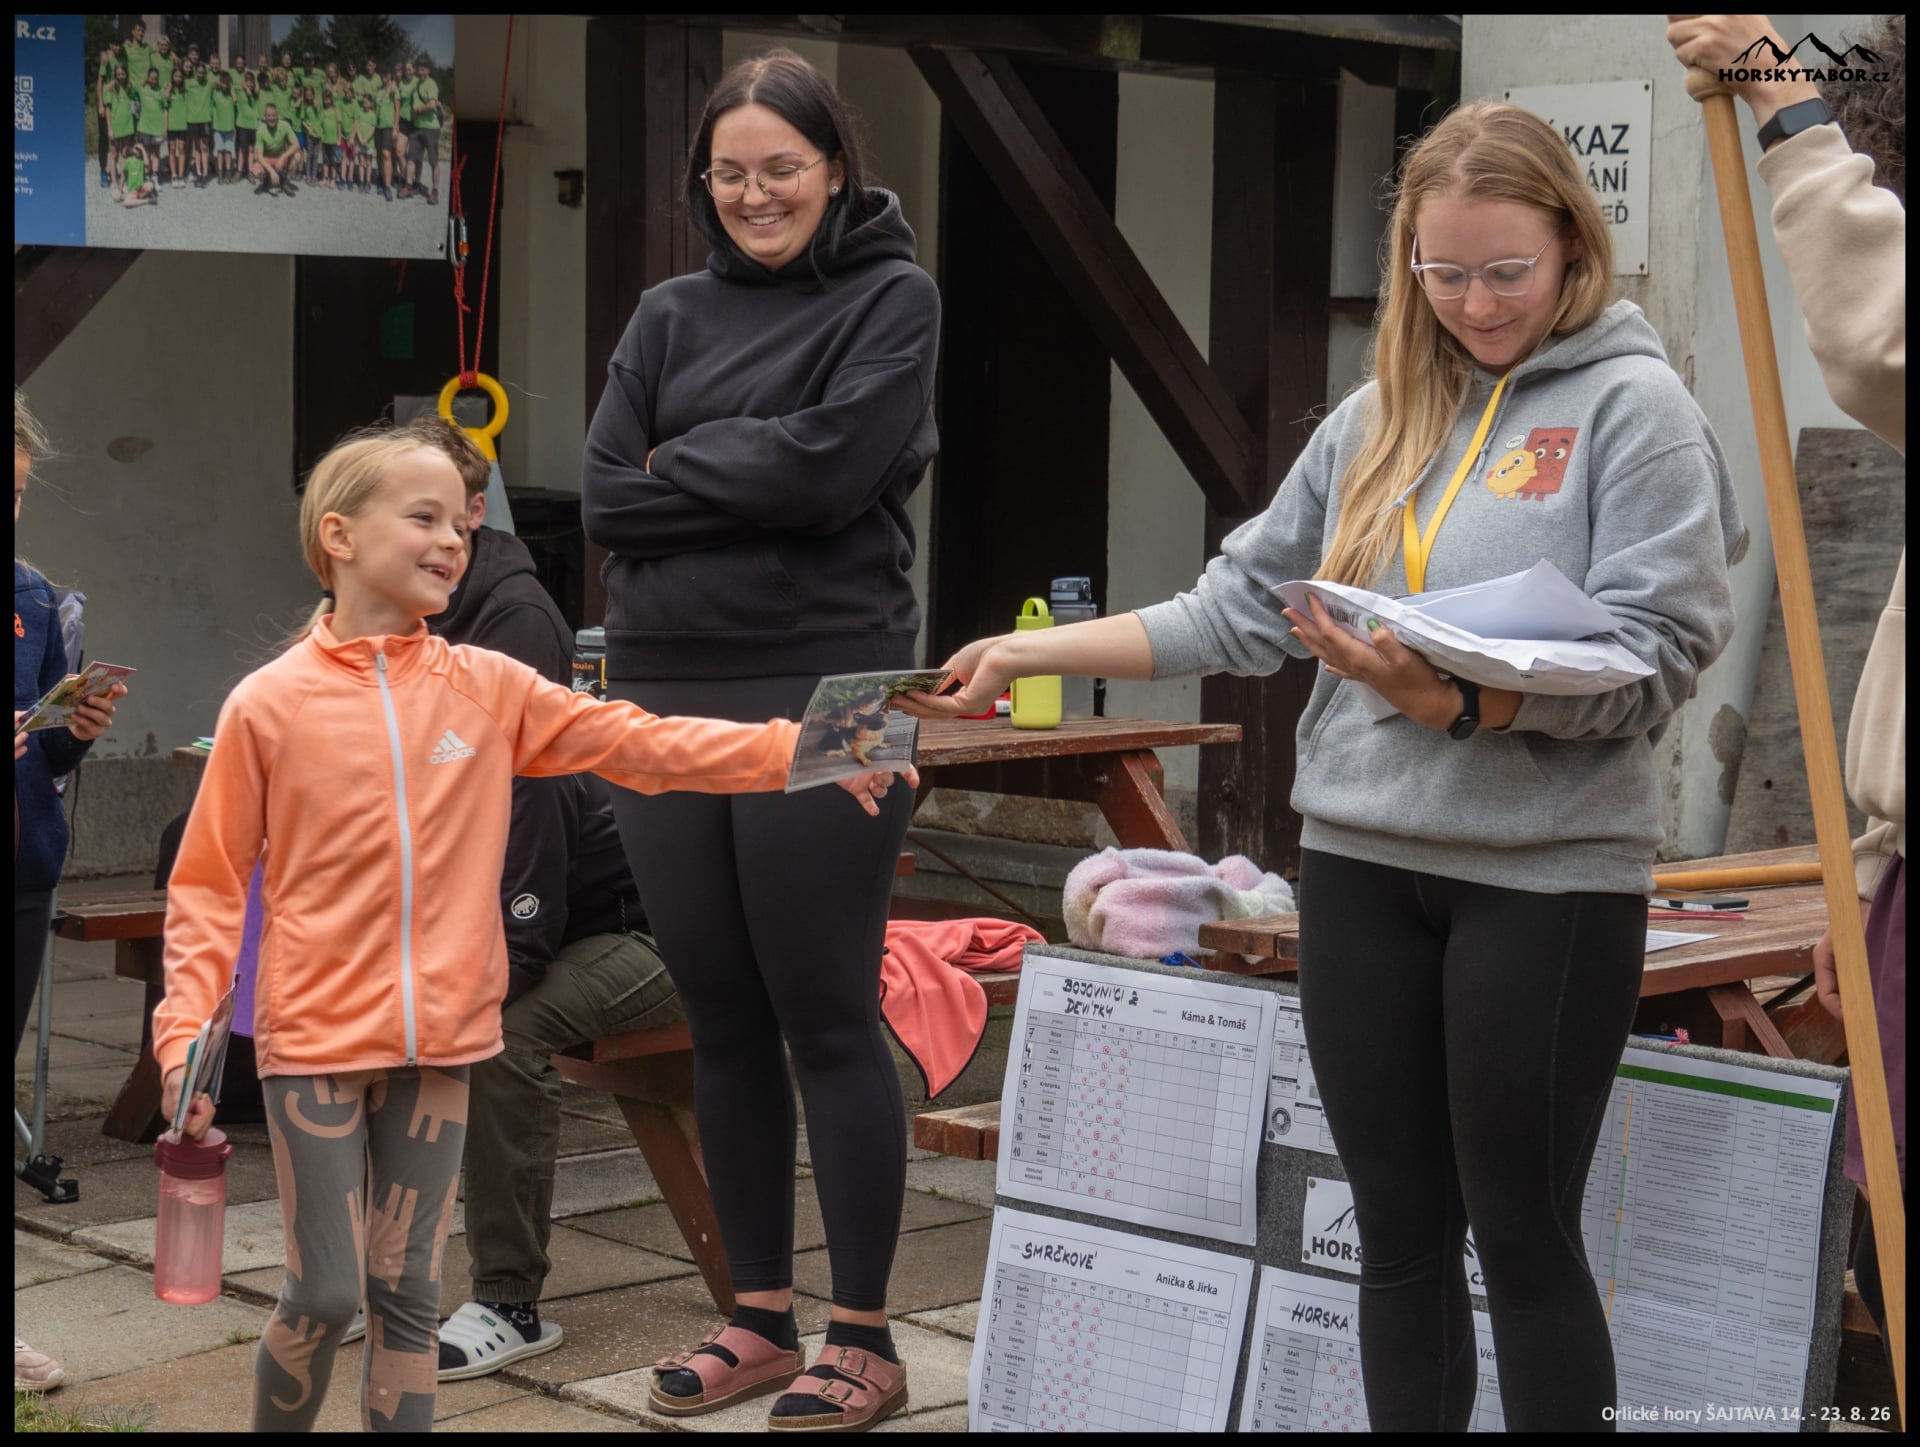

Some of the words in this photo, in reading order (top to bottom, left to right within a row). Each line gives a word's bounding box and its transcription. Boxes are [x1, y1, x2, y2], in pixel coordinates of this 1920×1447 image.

[1552, 121, 1630, 156] KAZ
[430, 747, 477, 765] adidas
[1181, 1010, 1206, 1024] Káma
[1207, 1014, 1215, 1025] &
[1217, 1016, 1247, 1031] Tomáš
[1022, 1242, 1098, 1270] SMRČKOVÉ
[1156, 1273, 1185, 1288] Anička
[1187, 1280, 1194, 1290] &
[1196, 1282, 1218, 1296] Jirka
[1291, 1302, 1353, 1334] HORSKÁ
[1262, 1362, 1268, 1375] 4
[1261, 1383, 1266, 1392] 5
[1258, 1400, 1263, 1409] 5
